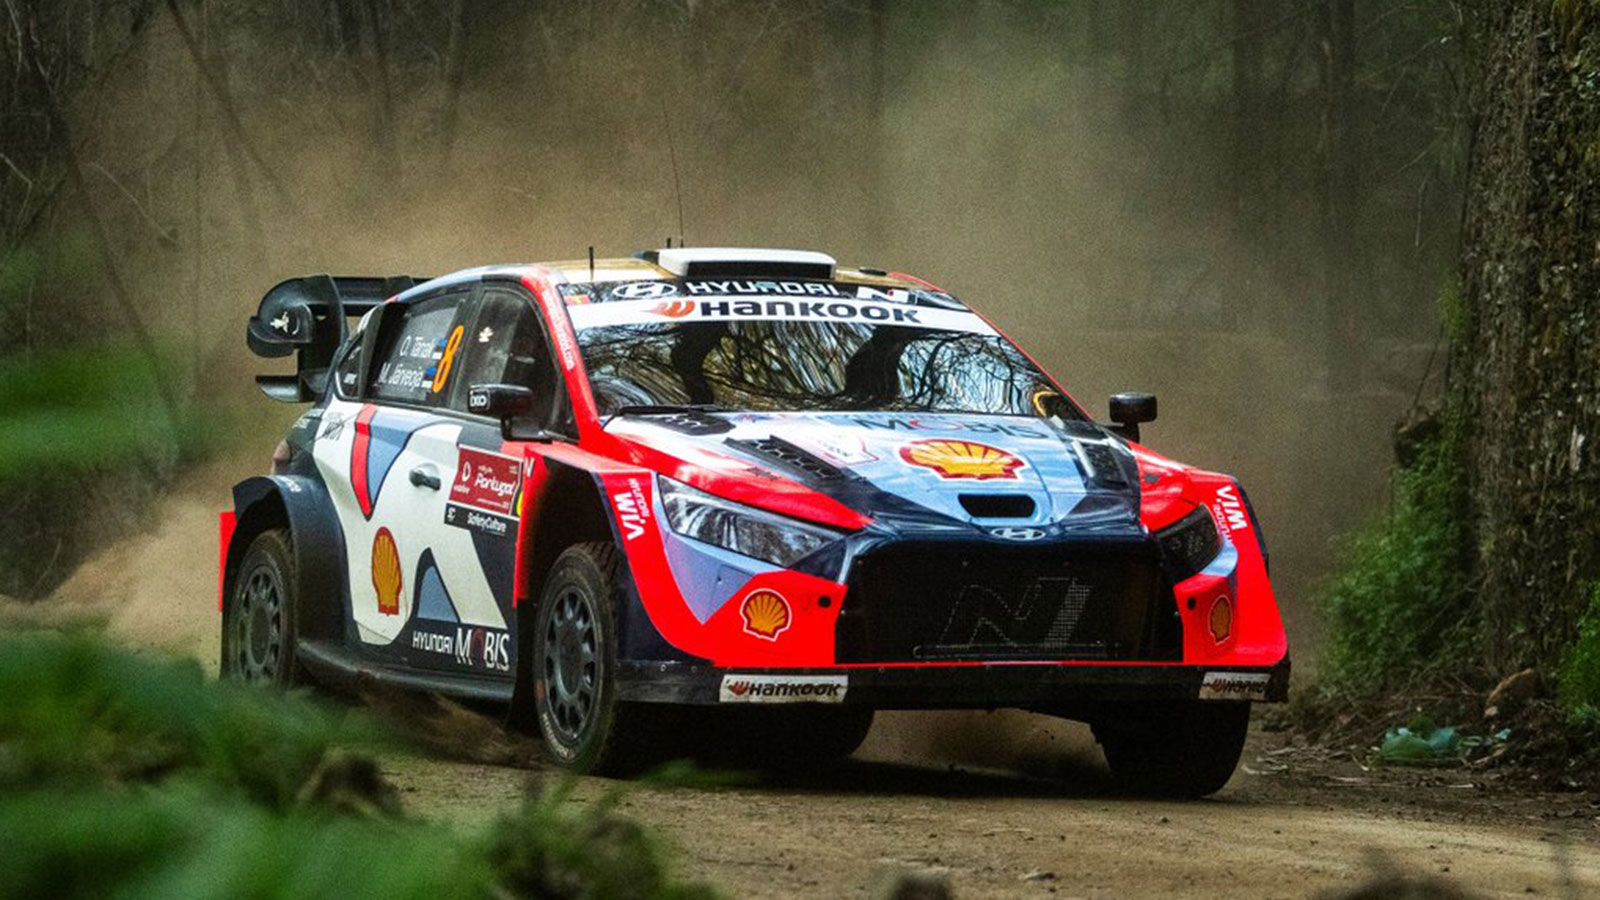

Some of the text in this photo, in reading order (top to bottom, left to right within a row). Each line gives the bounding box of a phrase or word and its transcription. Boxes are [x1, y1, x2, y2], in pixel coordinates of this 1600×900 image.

[686, 281, 839, 296] HYUNDAI
[433, 324, 465, 393] 8
[474, 473, 516, 496] Portugal
[412, 627, 511, 672] HYUNDAI MOBIS
